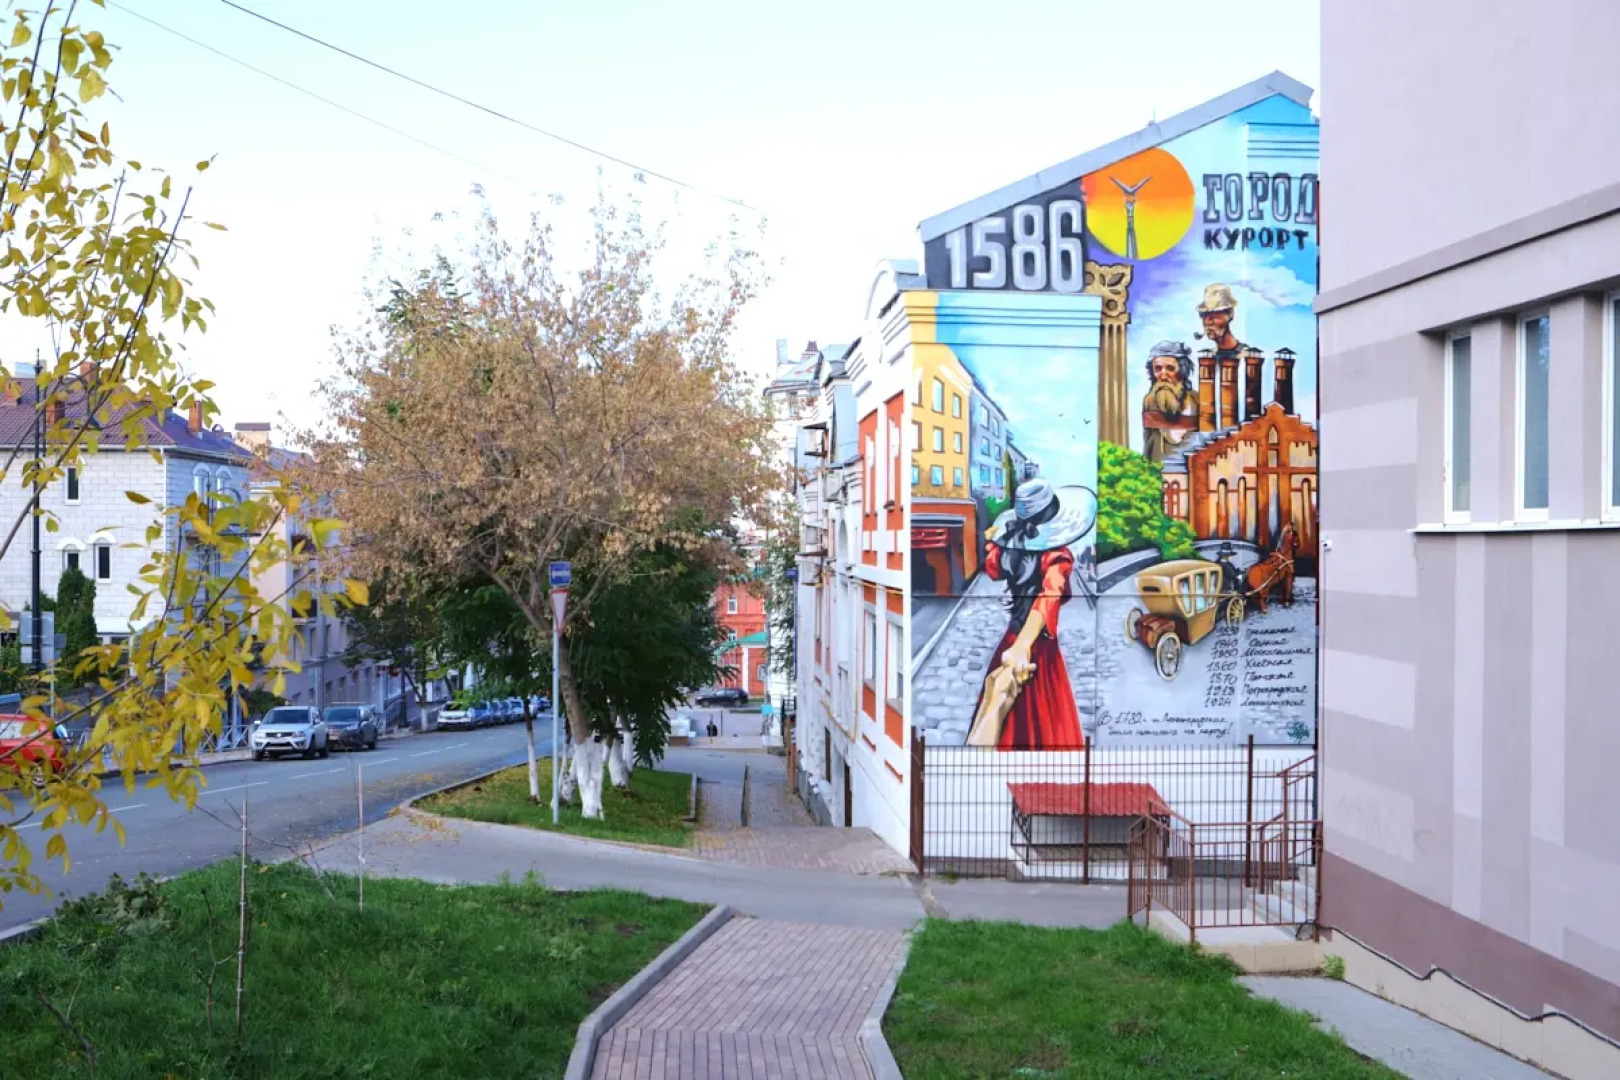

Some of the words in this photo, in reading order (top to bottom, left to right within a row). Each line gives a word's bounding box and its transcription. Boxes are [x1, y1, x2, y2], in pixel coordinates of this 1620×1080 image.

[1202, 171, 1319, 224] ГОРОД
[945, 199, 1083, 293] 1586
[1203, 227, 1309, 250] КУРОРТ
